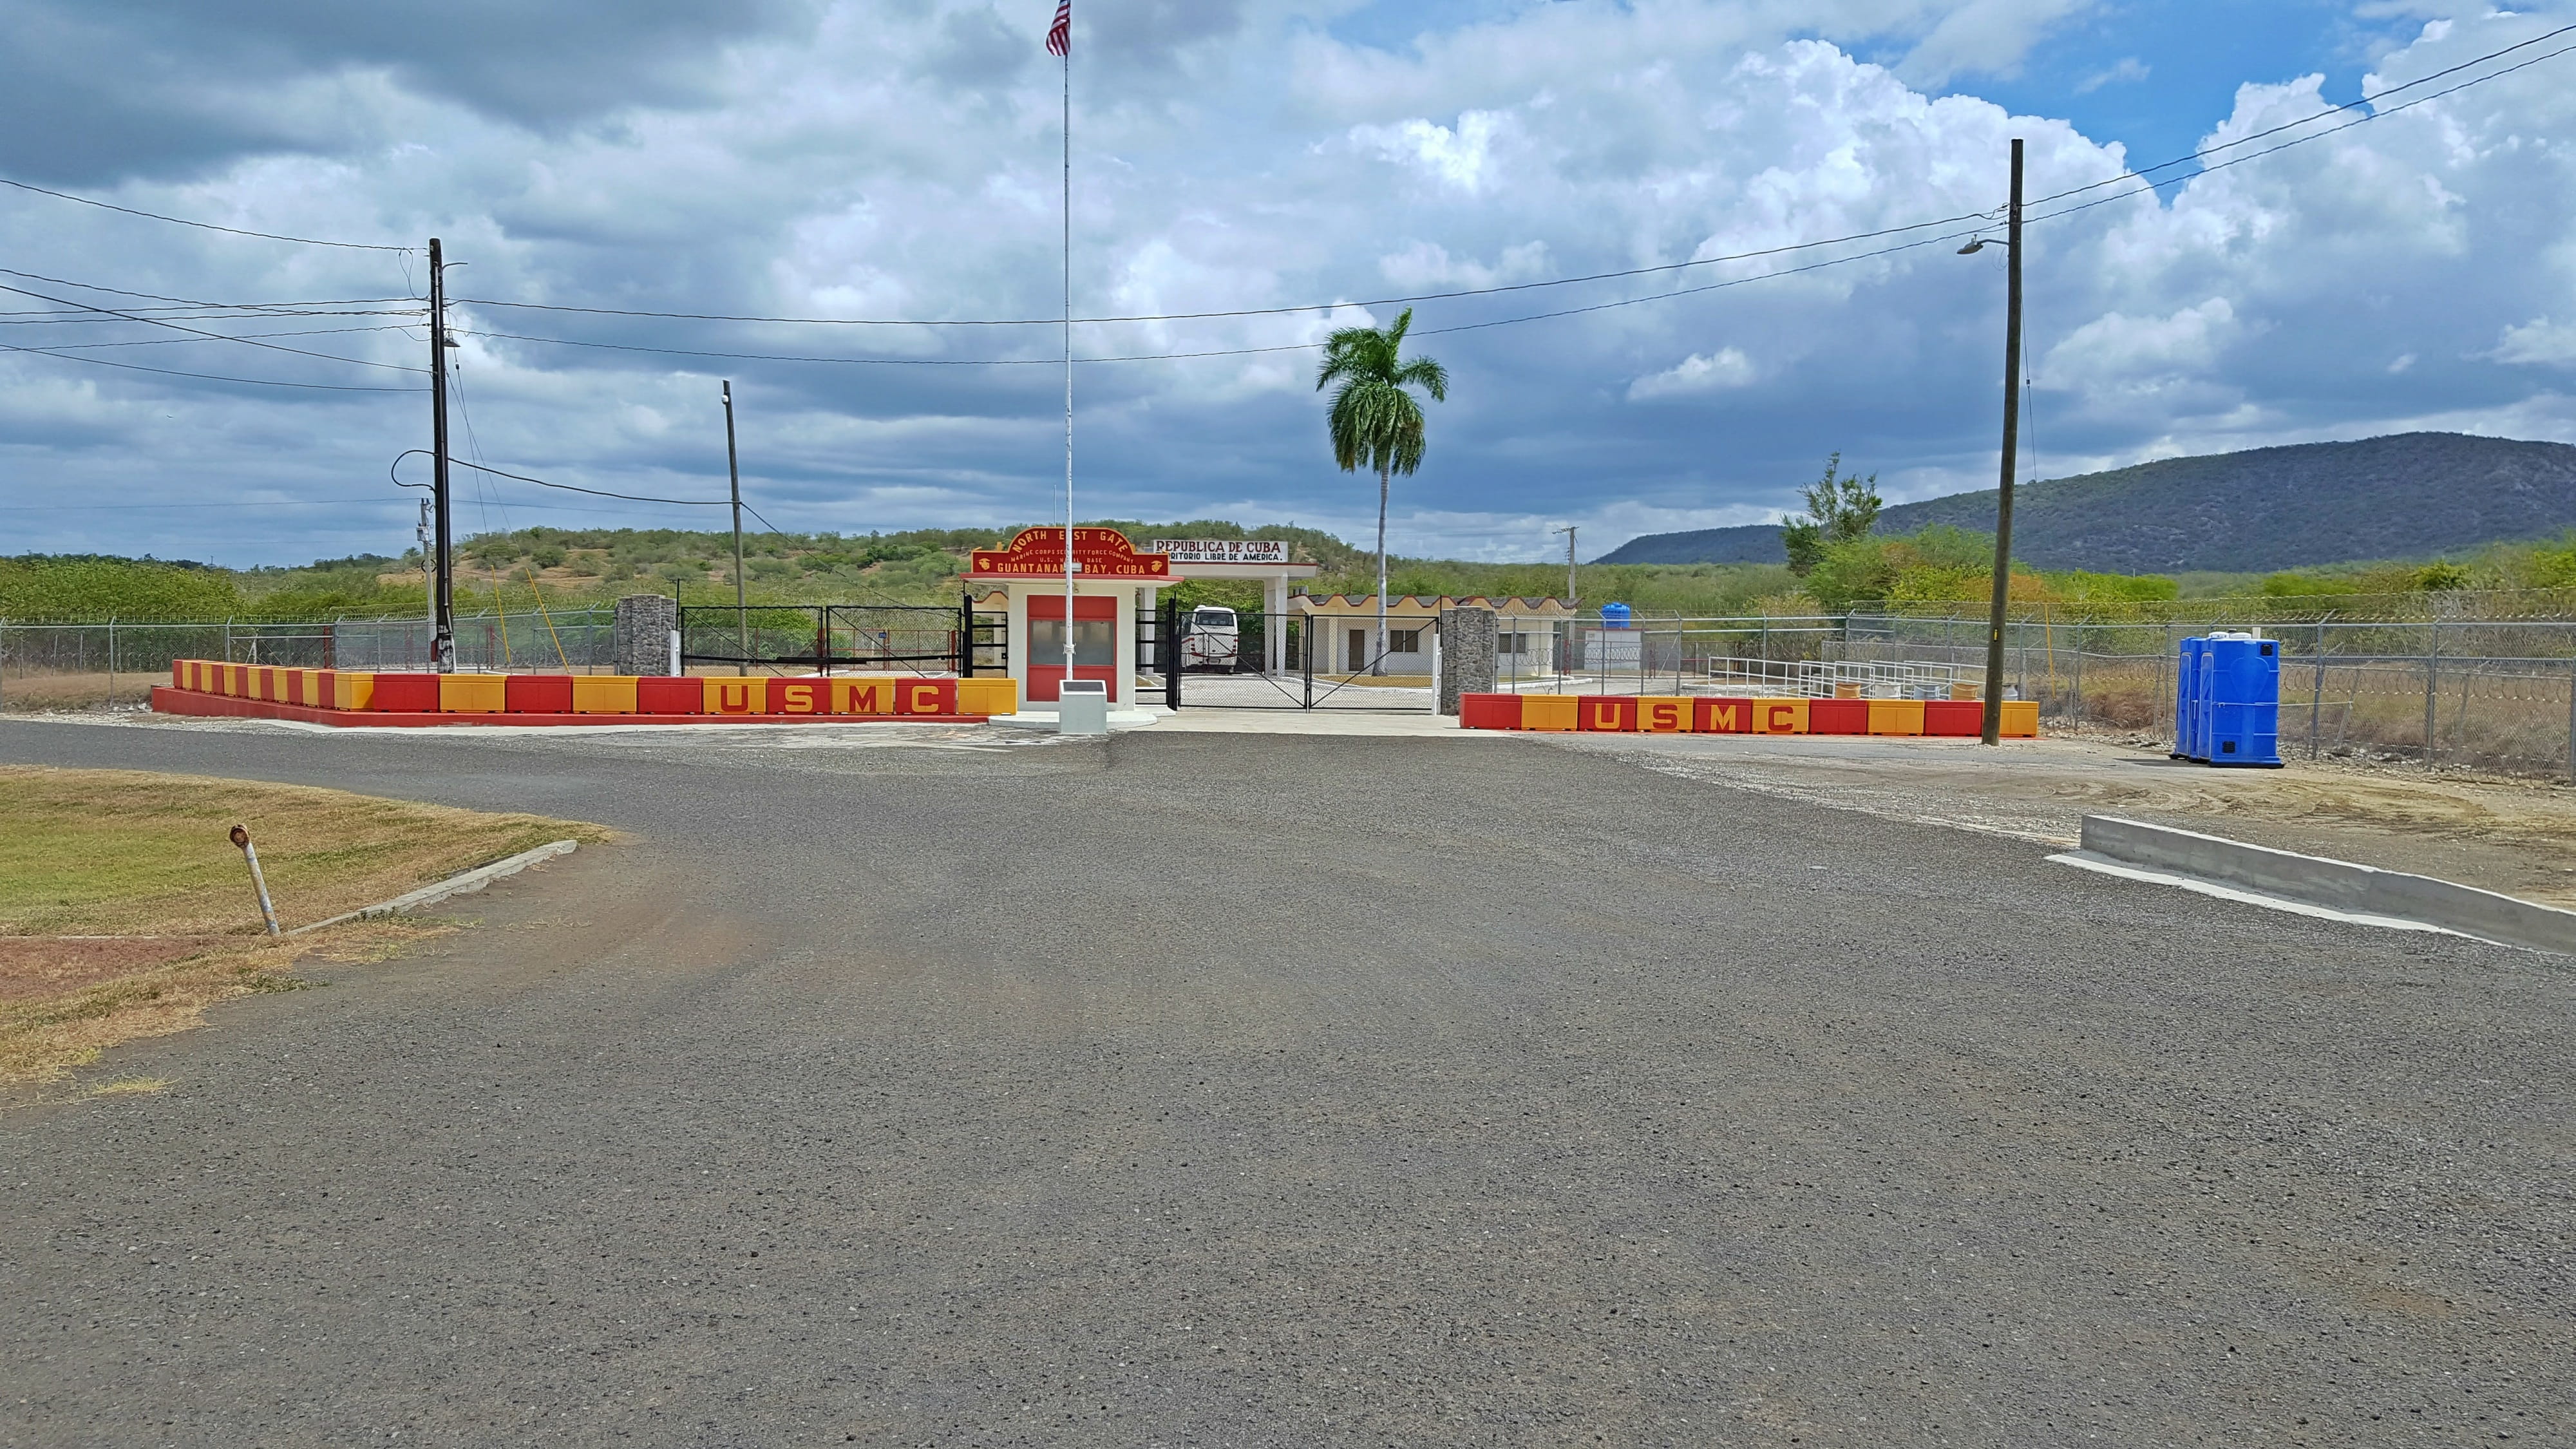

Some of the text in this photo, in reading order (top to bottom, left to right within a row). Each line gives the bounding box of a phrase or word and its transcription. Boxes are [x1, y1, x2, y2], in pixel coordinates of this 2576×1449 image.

[1012, 531, 1128, 553] NORTH EST GATE
[1156, 540, 1281, 553] REPUBLICA DE CUBA
[1010, 549, 1033, 562] MARINE
[1108, 550, 1134, 564] COMPANY
[1084, 564, 1111, 574] BAY,
[1116, 565, 1145, 574] CUBA
